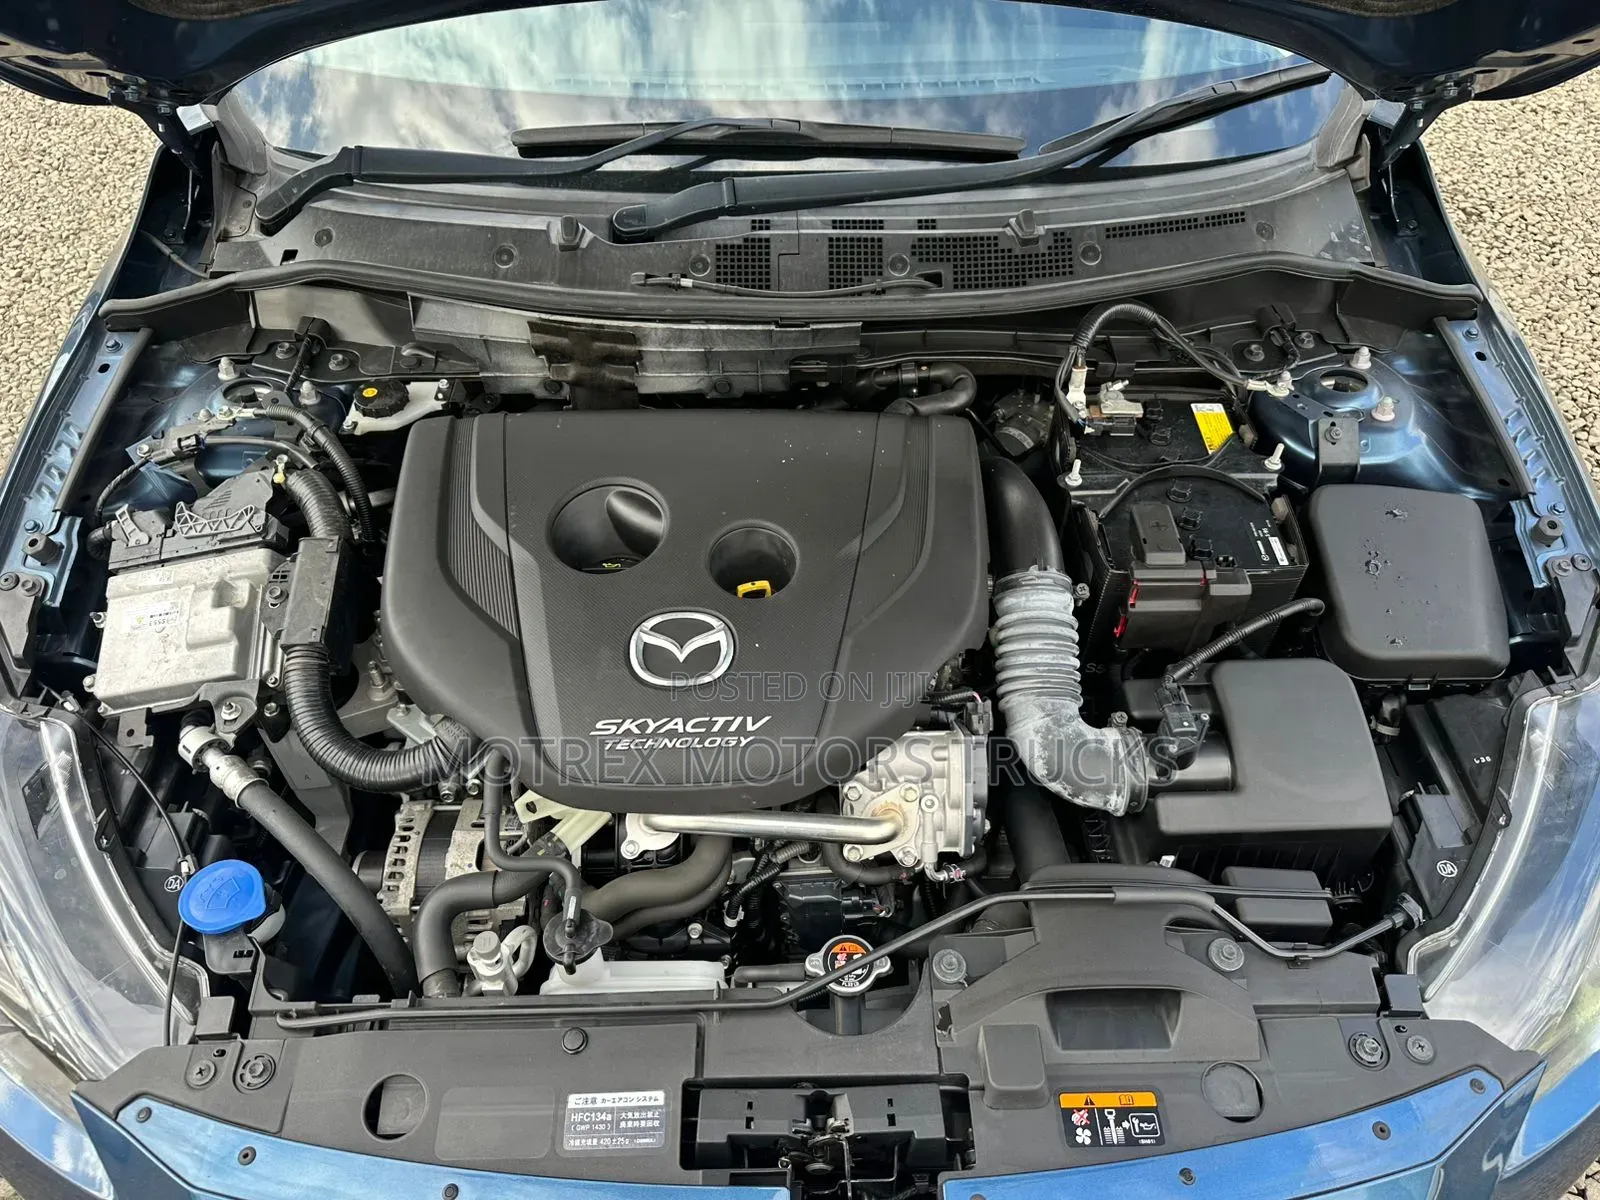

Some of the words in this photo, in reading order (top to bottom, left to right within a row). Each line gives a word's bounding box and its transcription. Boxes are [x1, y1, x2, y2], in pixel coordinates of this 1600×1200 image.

[589, 715, 773, 736] SKYACTIV
[603, 735, 755, 750] TECHNOLOGY
[570, 1111, 612, 1122] HFC134a
